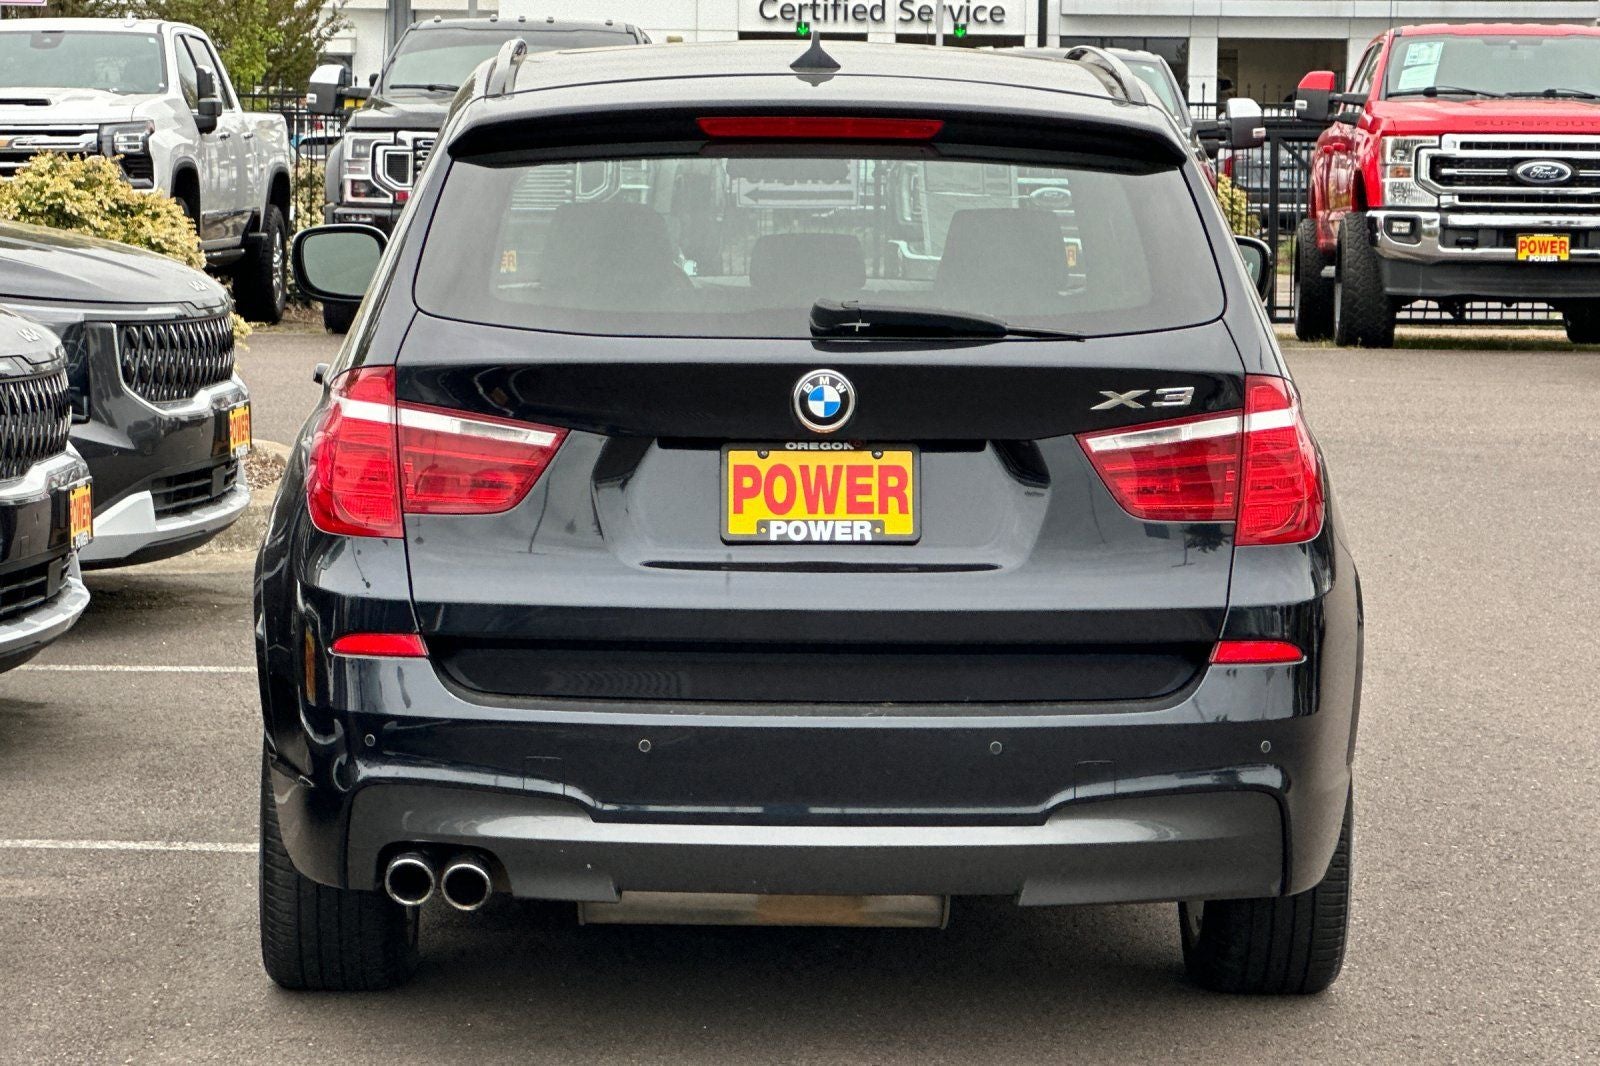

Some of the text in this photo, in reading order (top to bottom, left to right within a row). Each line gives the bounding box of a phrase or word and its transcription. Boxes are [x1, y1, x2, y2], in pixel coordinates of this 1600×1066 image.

[759, 0, 1006, 23] Certified Sevice
[1530, 165, 1559, 179] Ford
[1519, 240, 1568, 254] POWER
[802, 376, 846, 394] BMW
[1090, 386, 1195, 410] X3
[785, 441, 855, 451] OREGON
[733, 463, 909, 516] POWER
[769, 520, 872, 541] POWER
